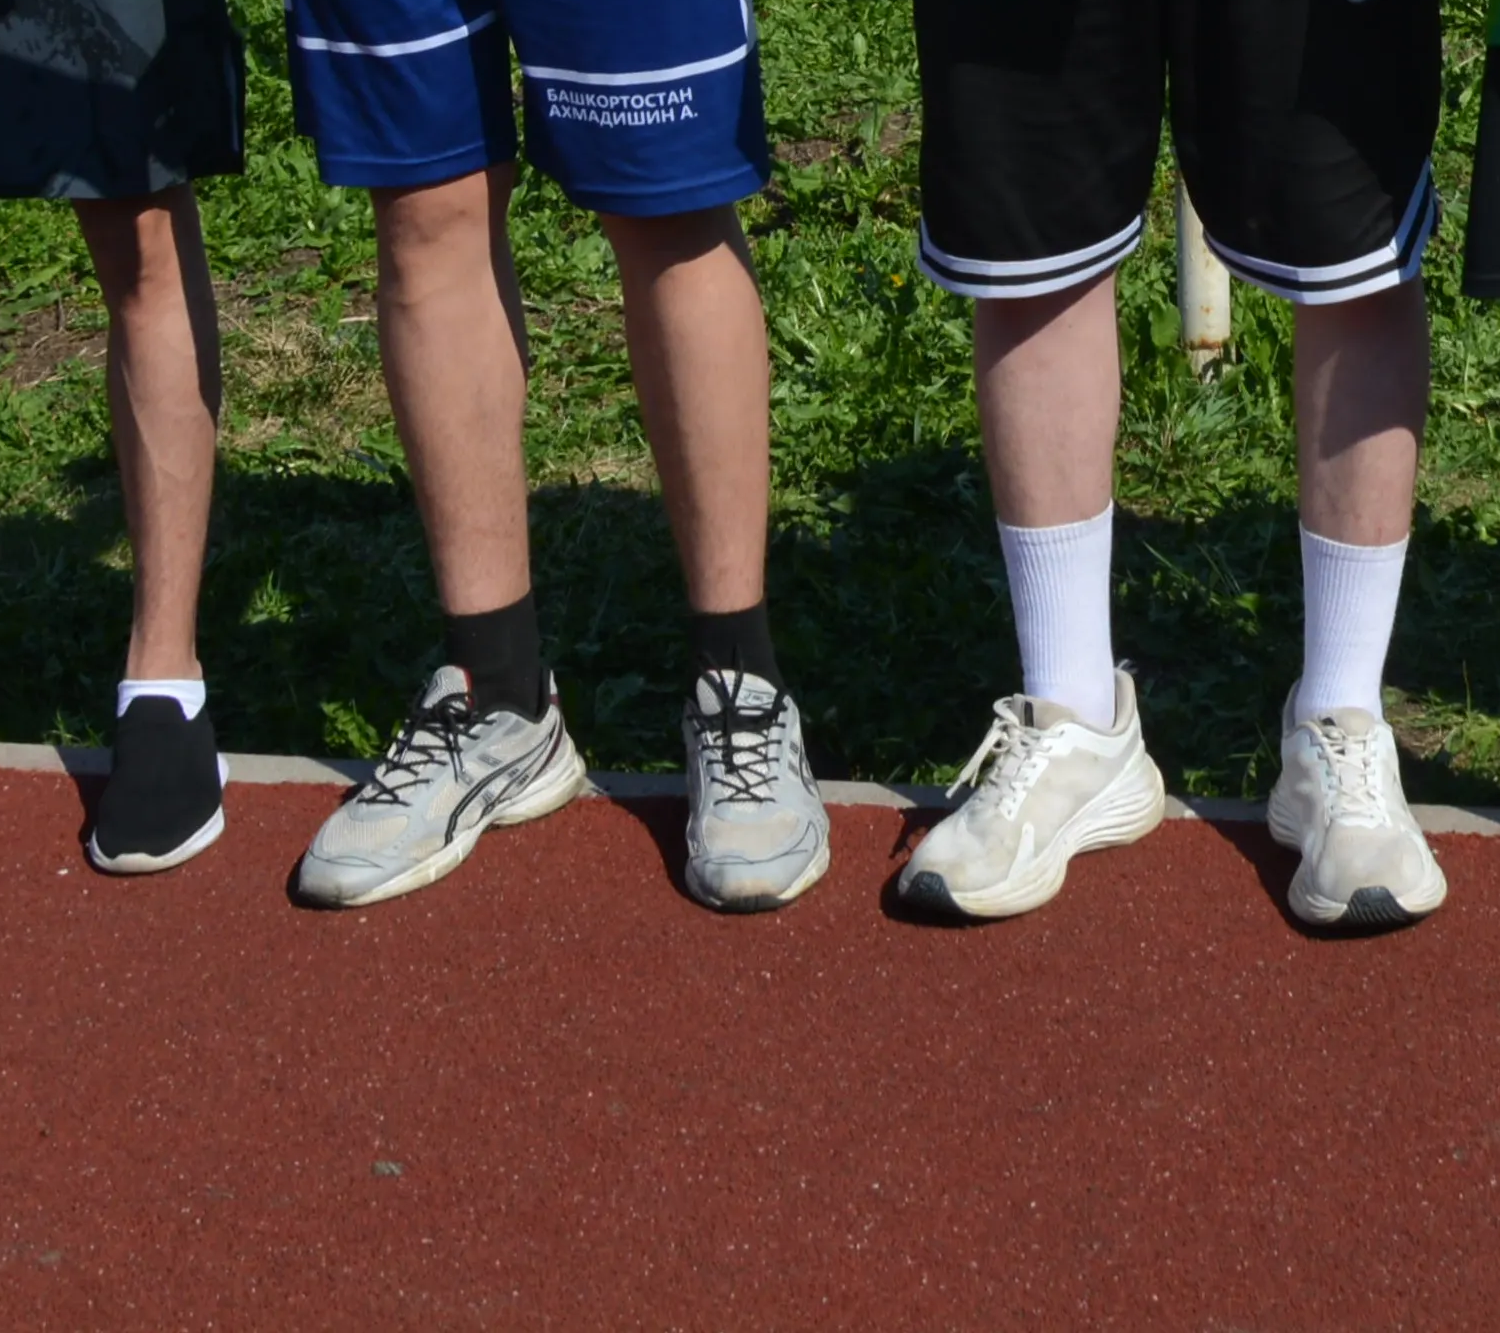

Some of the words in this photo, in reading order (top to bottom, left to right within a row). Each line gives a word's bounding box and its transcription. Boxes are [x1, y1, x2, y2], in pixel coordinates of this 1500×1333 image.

[546, 86, 694, 110] БАШКОРТОСТАН
[549, 103, 676, 129] АХМАДИШИН
[680, 104, 699, 121] А.
